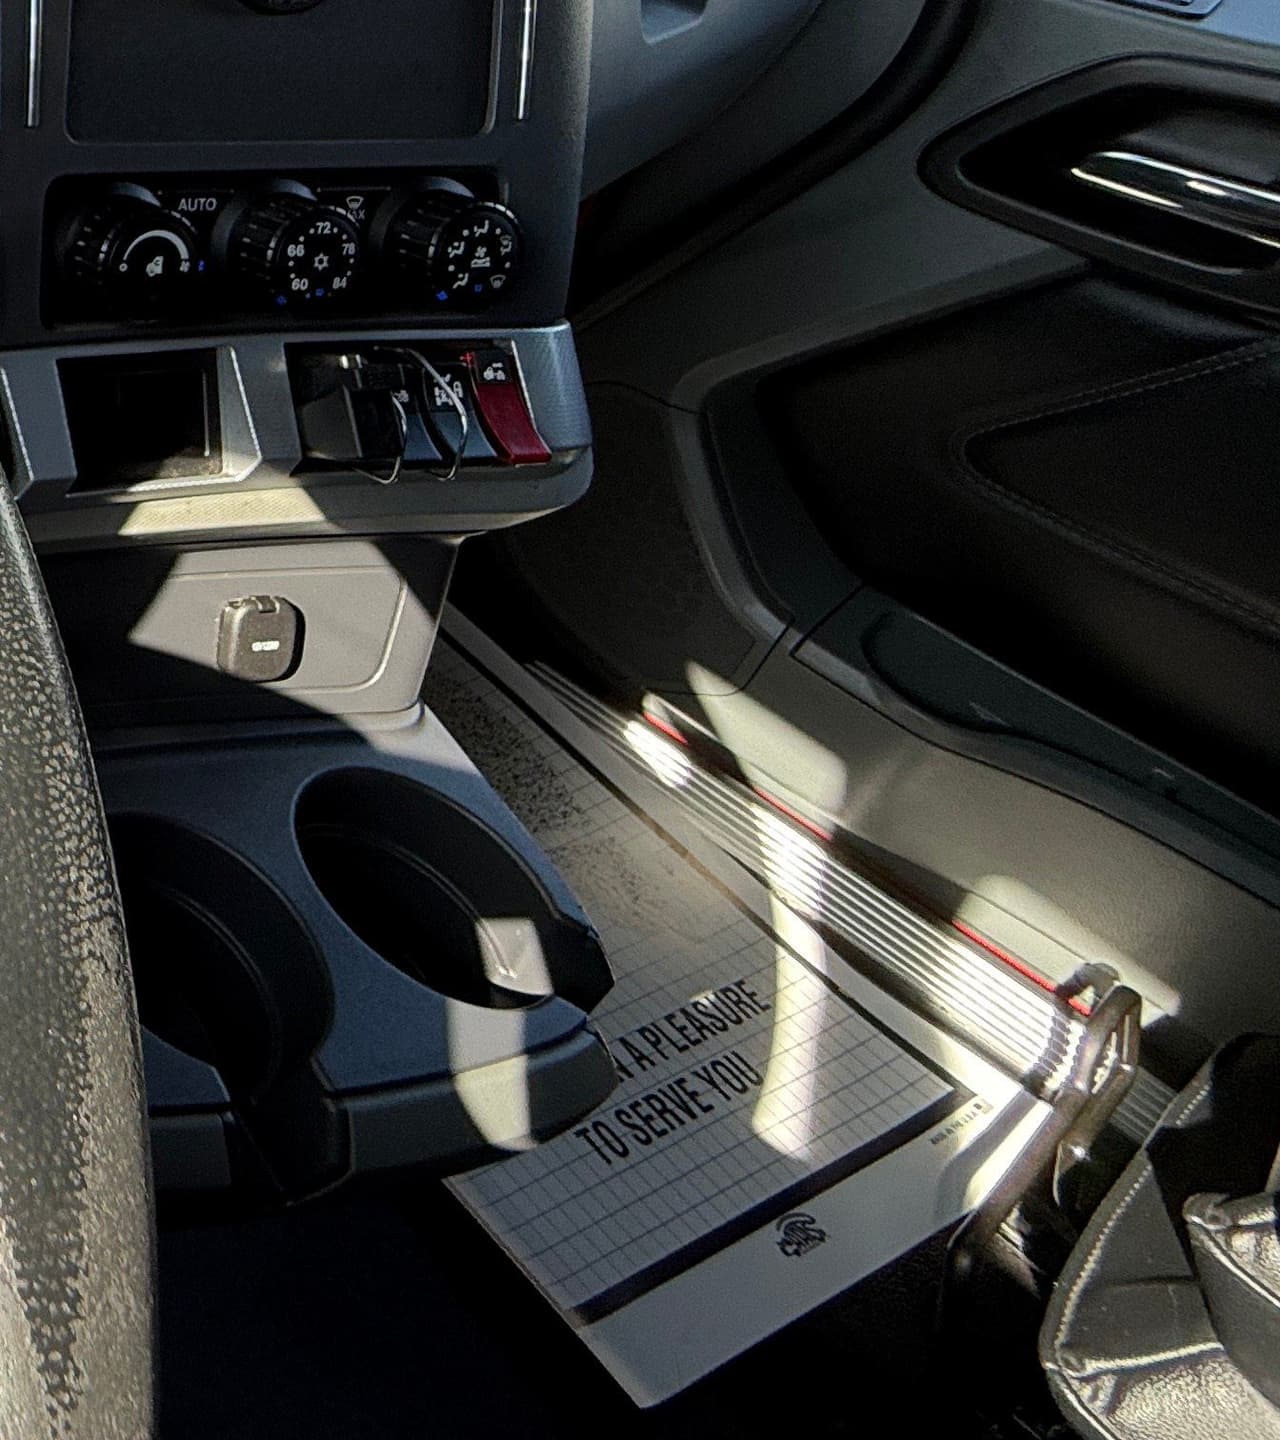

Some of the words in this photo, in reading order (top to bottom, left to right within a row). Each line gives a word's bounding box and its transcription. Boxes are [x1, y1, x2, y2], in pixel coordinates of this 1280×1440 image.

[177, 196, 218, 214] AUTO
[316, 221, 332, 235] 72
[287, 242, 306, 258] 66
[342, 243, 356, 257] 78
[290, 277, 310, 292] 60
[332, 275, 348, 290] 84
[637, 978, 772, 1063] PLEASURE
[621, 1036, 654, 1072] A
[572, 1120, 630, 1166] TO
[614, 1077, 716, 1147] SERVE
[691, 1048, 765, 1102] YOU
